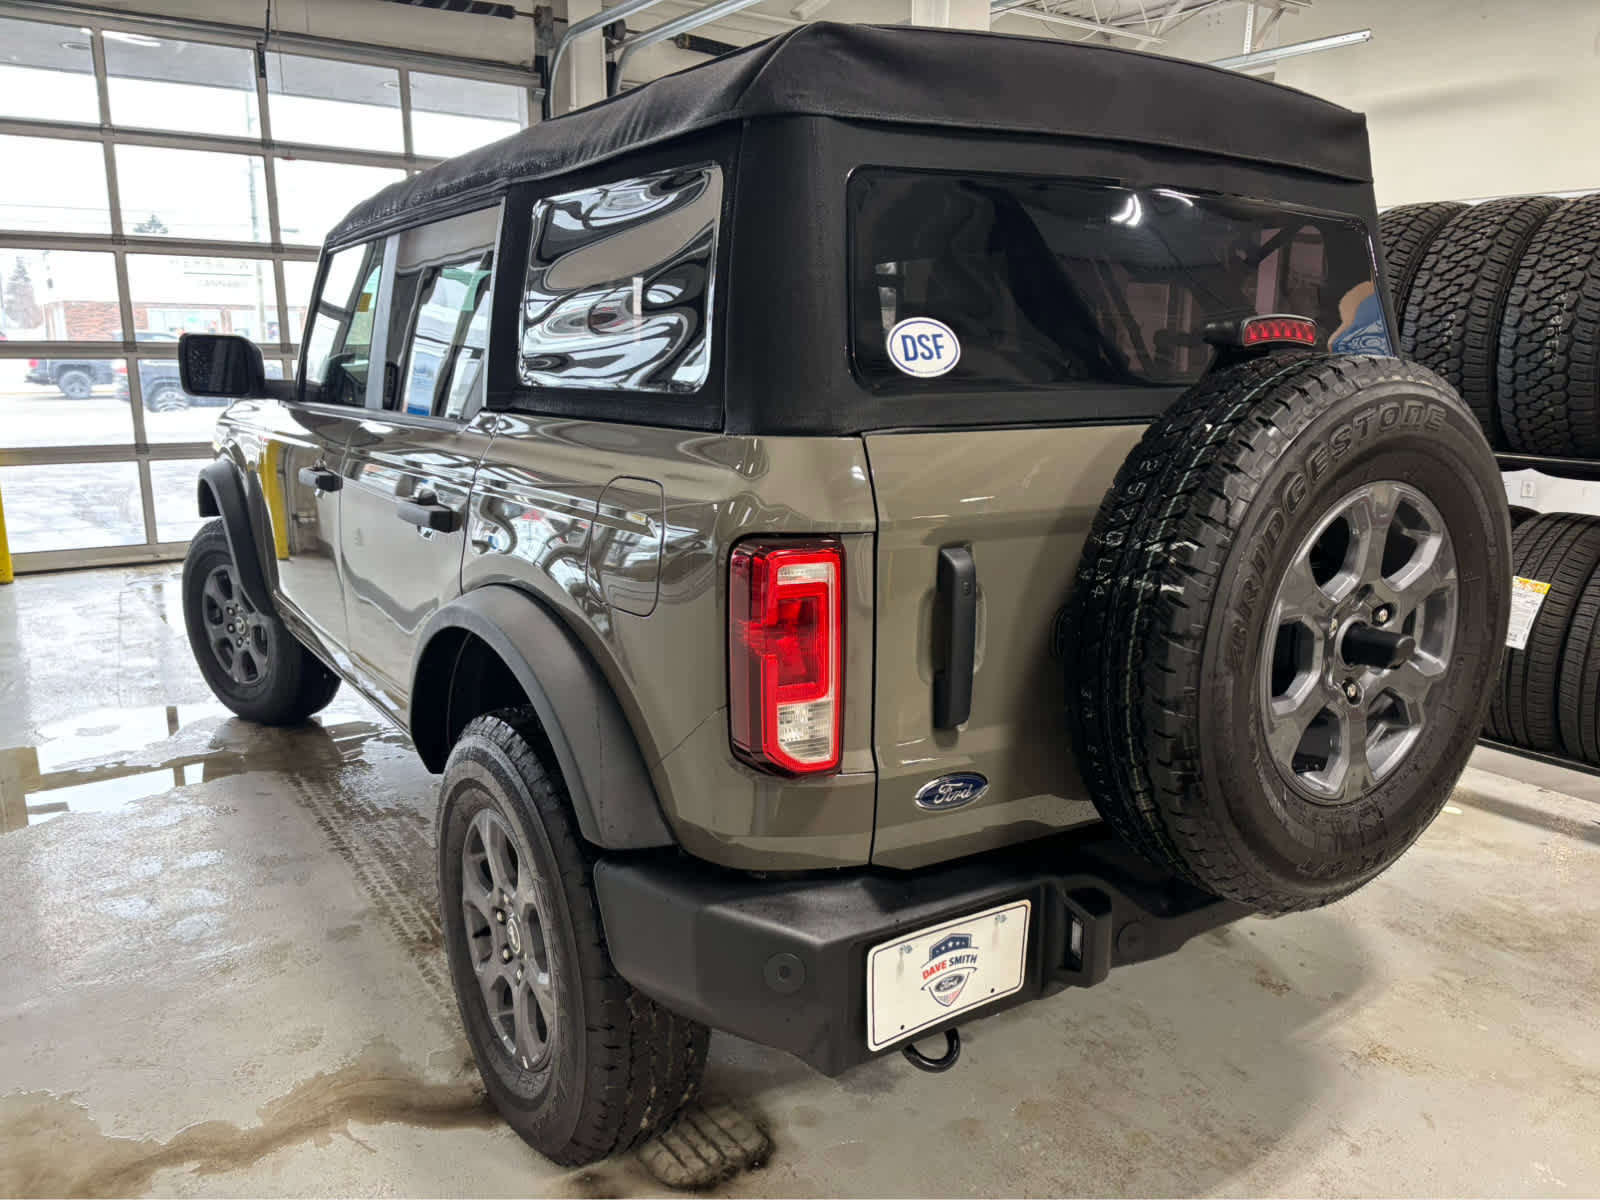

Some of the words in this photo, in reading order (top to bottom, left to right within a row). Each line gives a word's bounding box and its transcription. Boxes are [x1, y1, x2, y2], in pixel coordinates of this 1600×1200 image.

[901, 333, 945, 361] DSF
[1230, 400, 1448, 664] BRIDGESTONE
[934, 782, 974, 804] Ford
[922, 959, 947, 980] DAVE
[948, 953, 978, 967] SMITH
